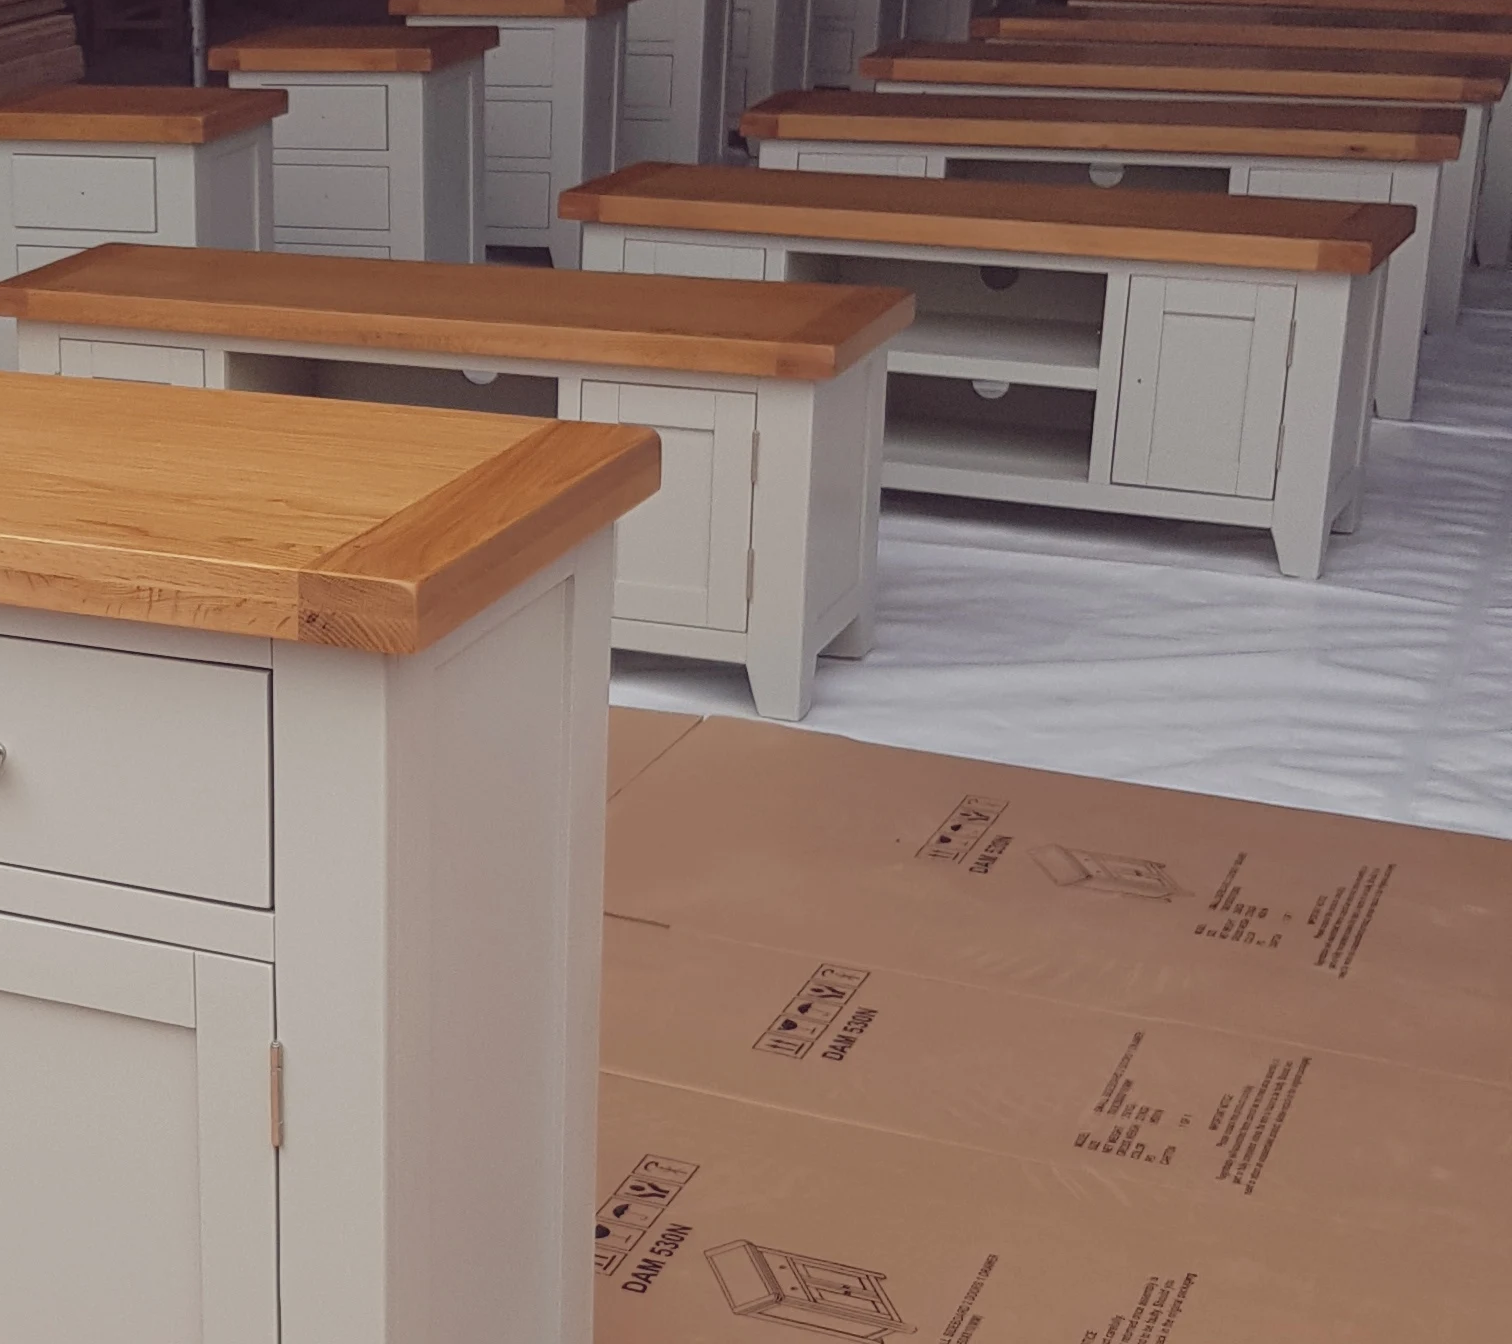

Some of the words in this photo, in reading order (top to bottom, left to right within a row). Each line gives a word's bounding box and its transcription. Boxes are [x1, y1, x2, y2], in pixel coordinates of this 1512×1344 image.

[821, 1034, 857, 1061] DAM
[843, 1006, 878, 1033] 530N
[621, 1258, 666, 1294] DAM
[649, 1223, 693, 1257] 530N
